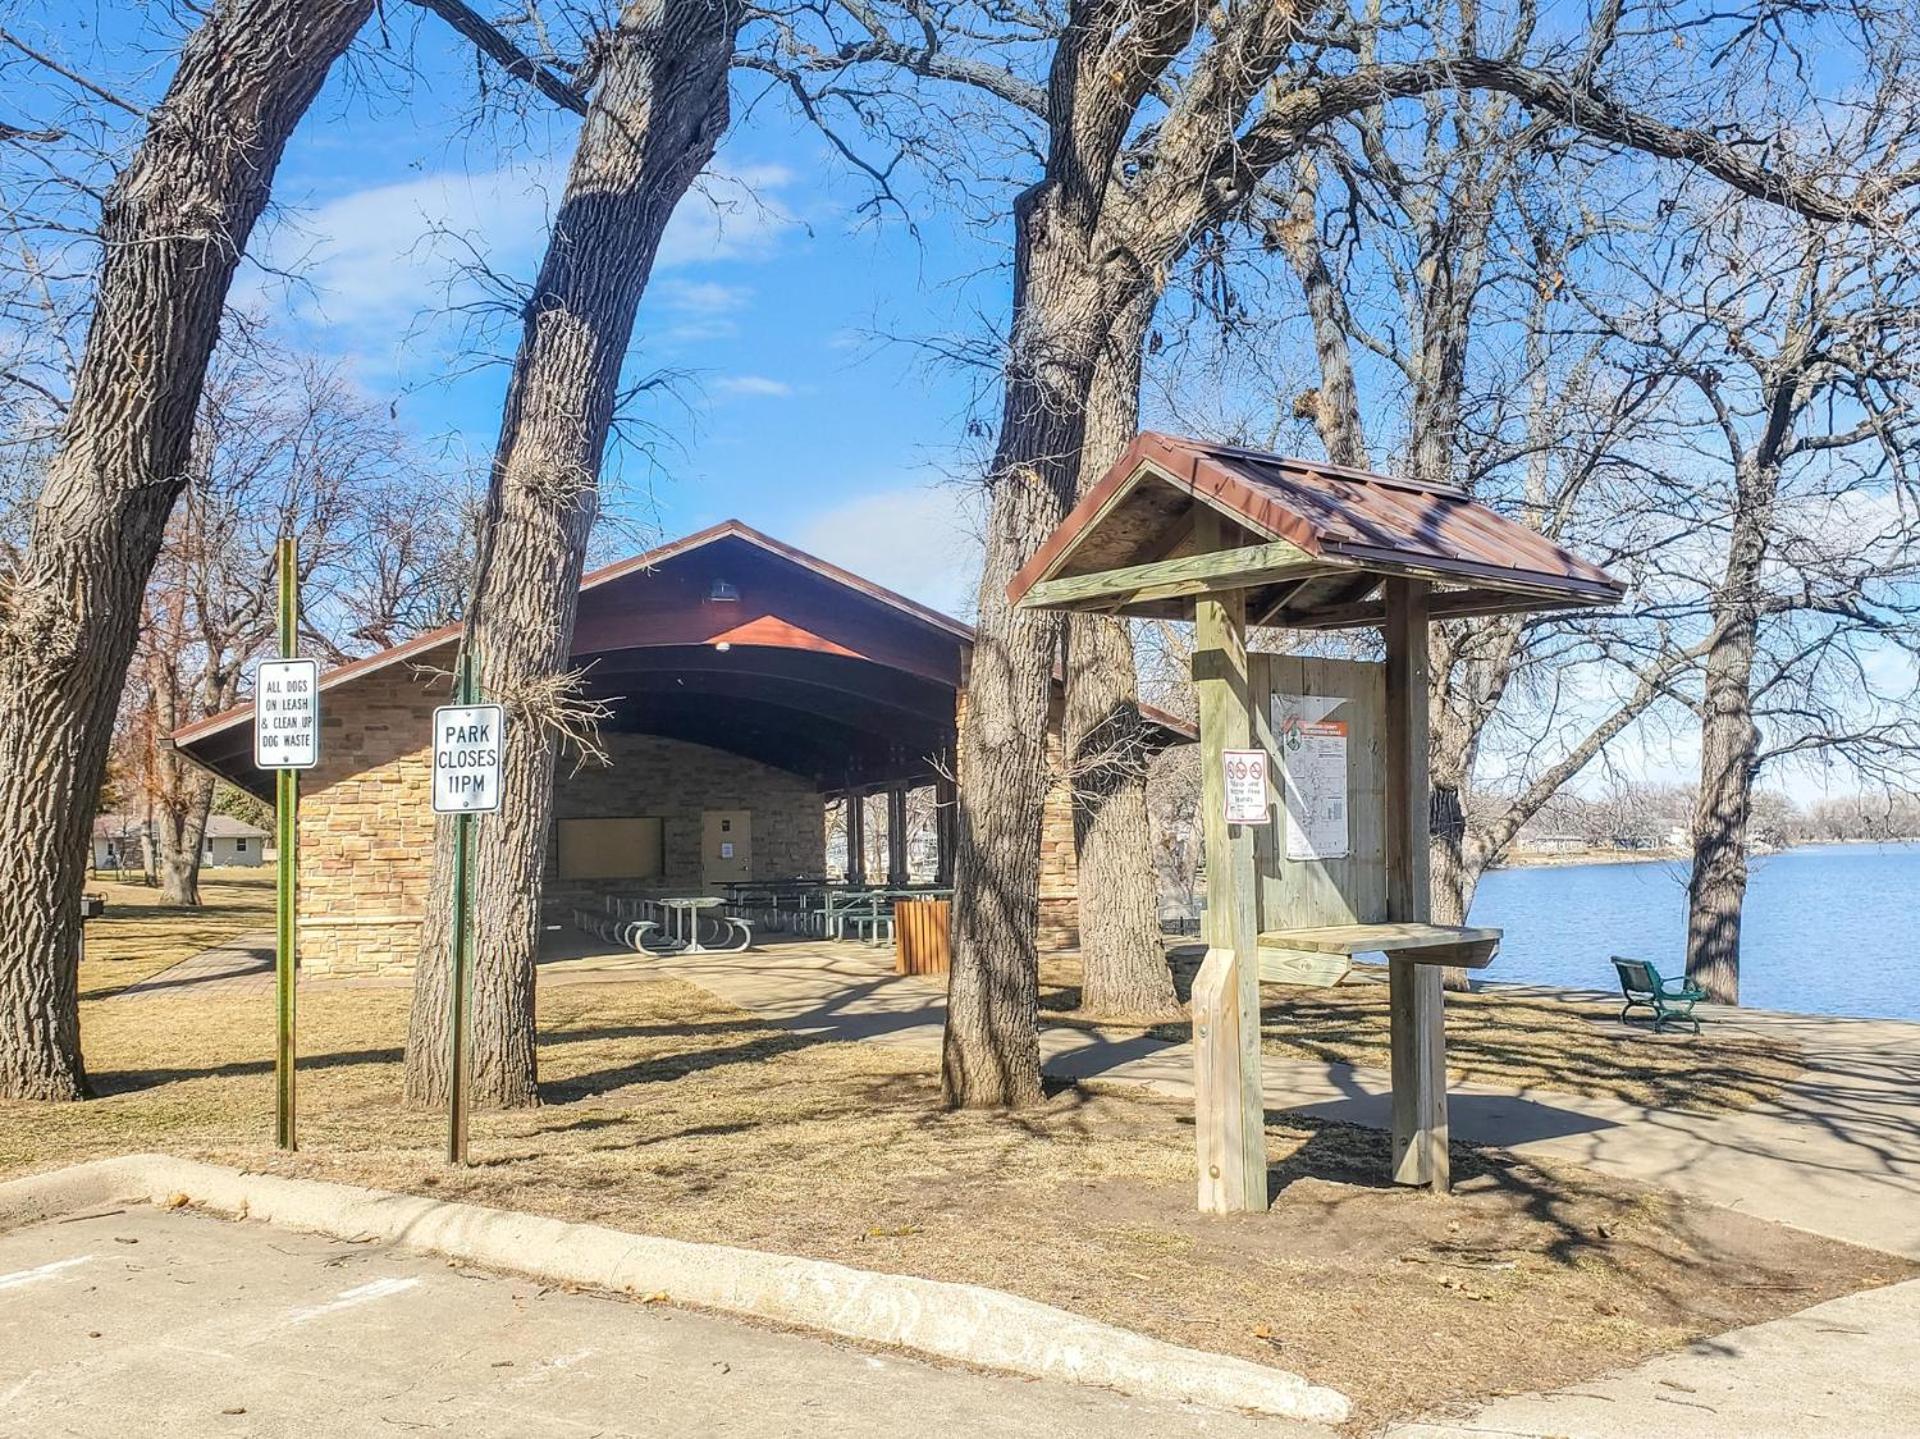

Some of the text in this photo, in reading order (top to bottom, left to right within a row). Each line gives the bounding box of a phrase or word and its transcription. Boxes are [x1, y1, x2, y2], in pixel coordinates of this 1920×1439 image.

[267, 681, 308, 693] ALL DOGS
[266, 699, 308, 711] ON LEASH
[261, 716, 312, 729] & CLEAN UP
[446, 725, 489, 743] PARK
[263, 735, 310, 747] DOG WASTE
[438, 749, 496, 768] CLOSES
[449, 775, 484, 793] 11PM
